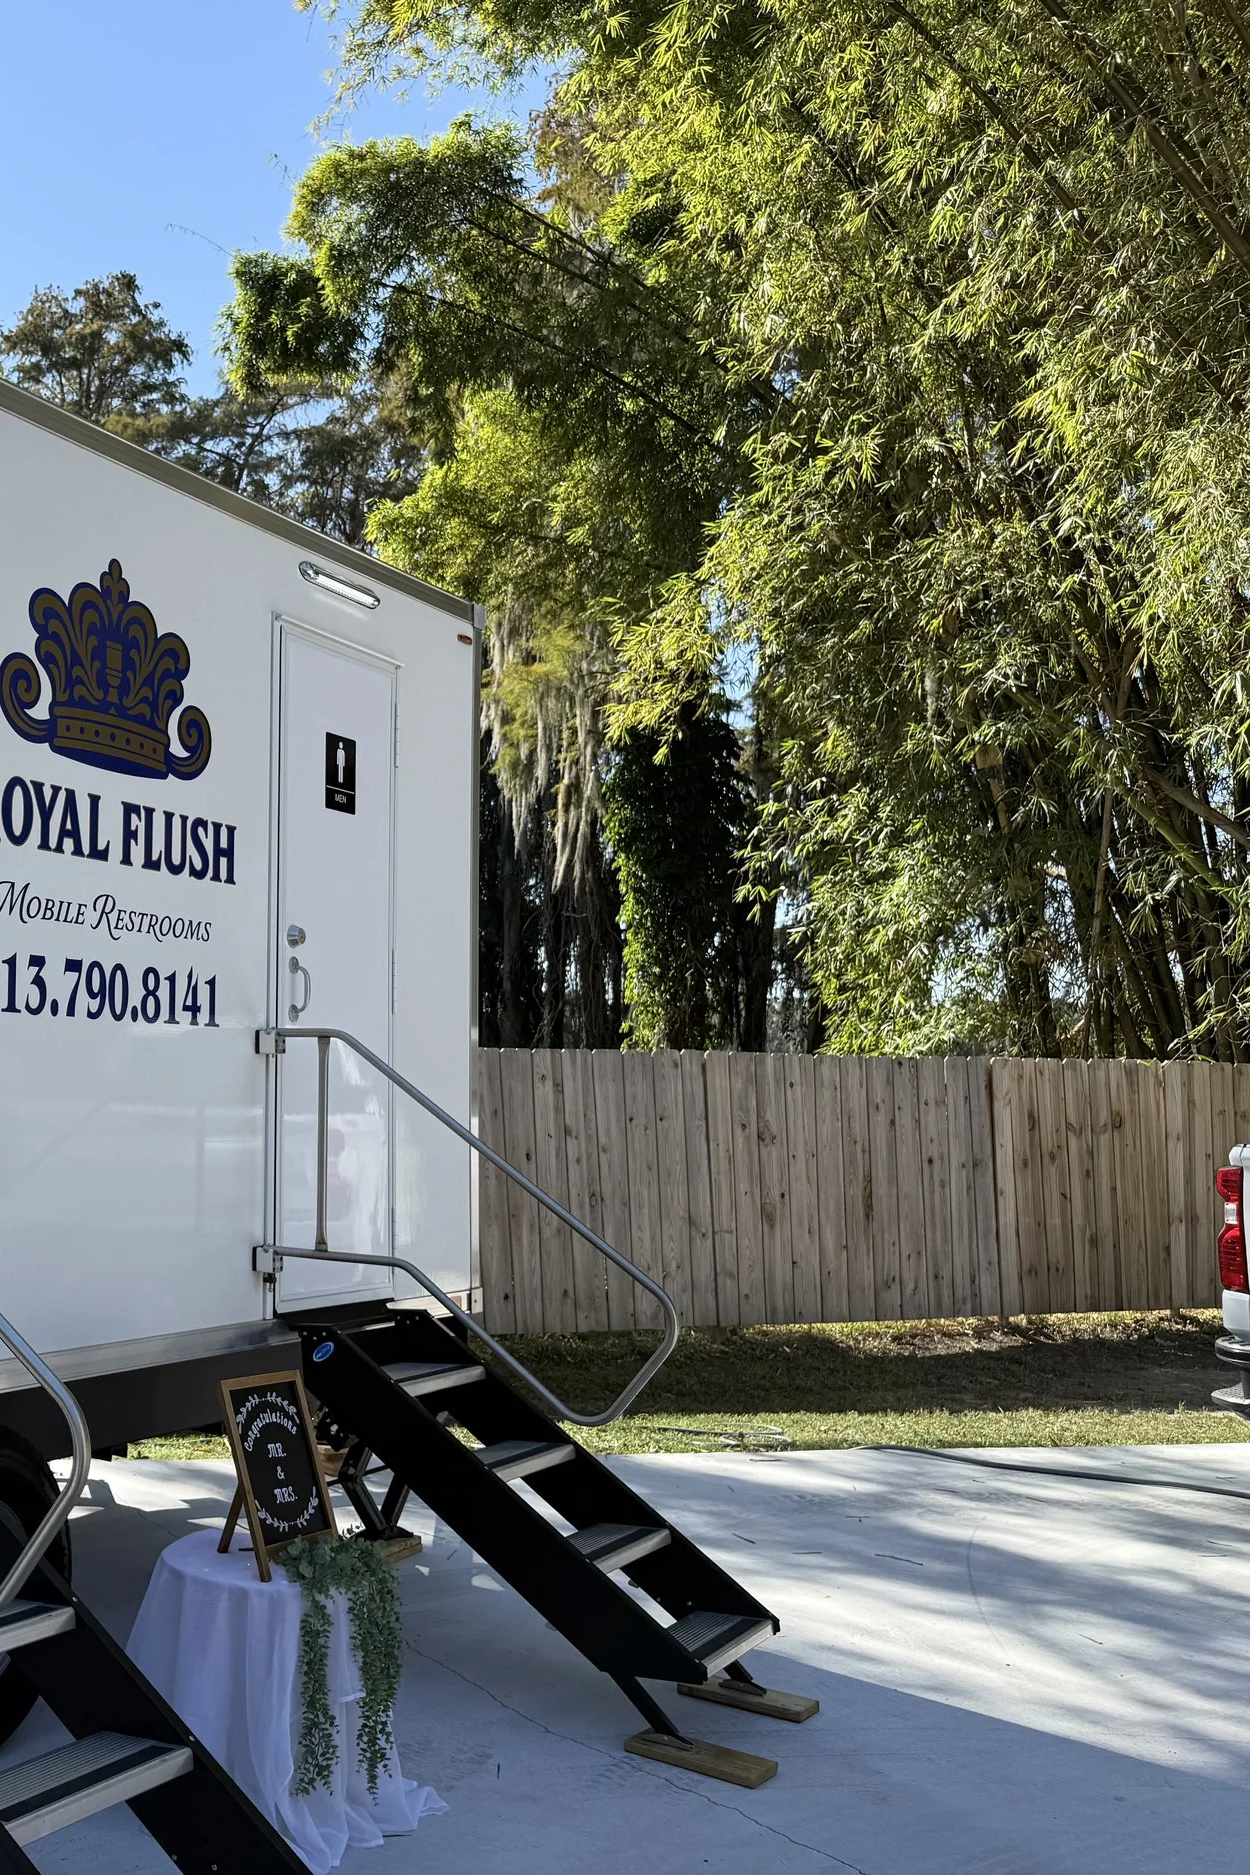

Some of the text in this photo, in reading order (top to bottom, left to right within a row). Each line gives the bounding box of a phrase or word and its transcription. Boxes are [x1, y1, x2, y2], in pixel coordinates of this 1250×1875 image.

[334, 793, 347, 804] MEN
[119, 800, 237, 885] FLUSH
[90, 894, 212, 943] RESTROOMS
[244, 1408, 297, 1452] Congratulations
[276, 1465, 285, 1480] &
